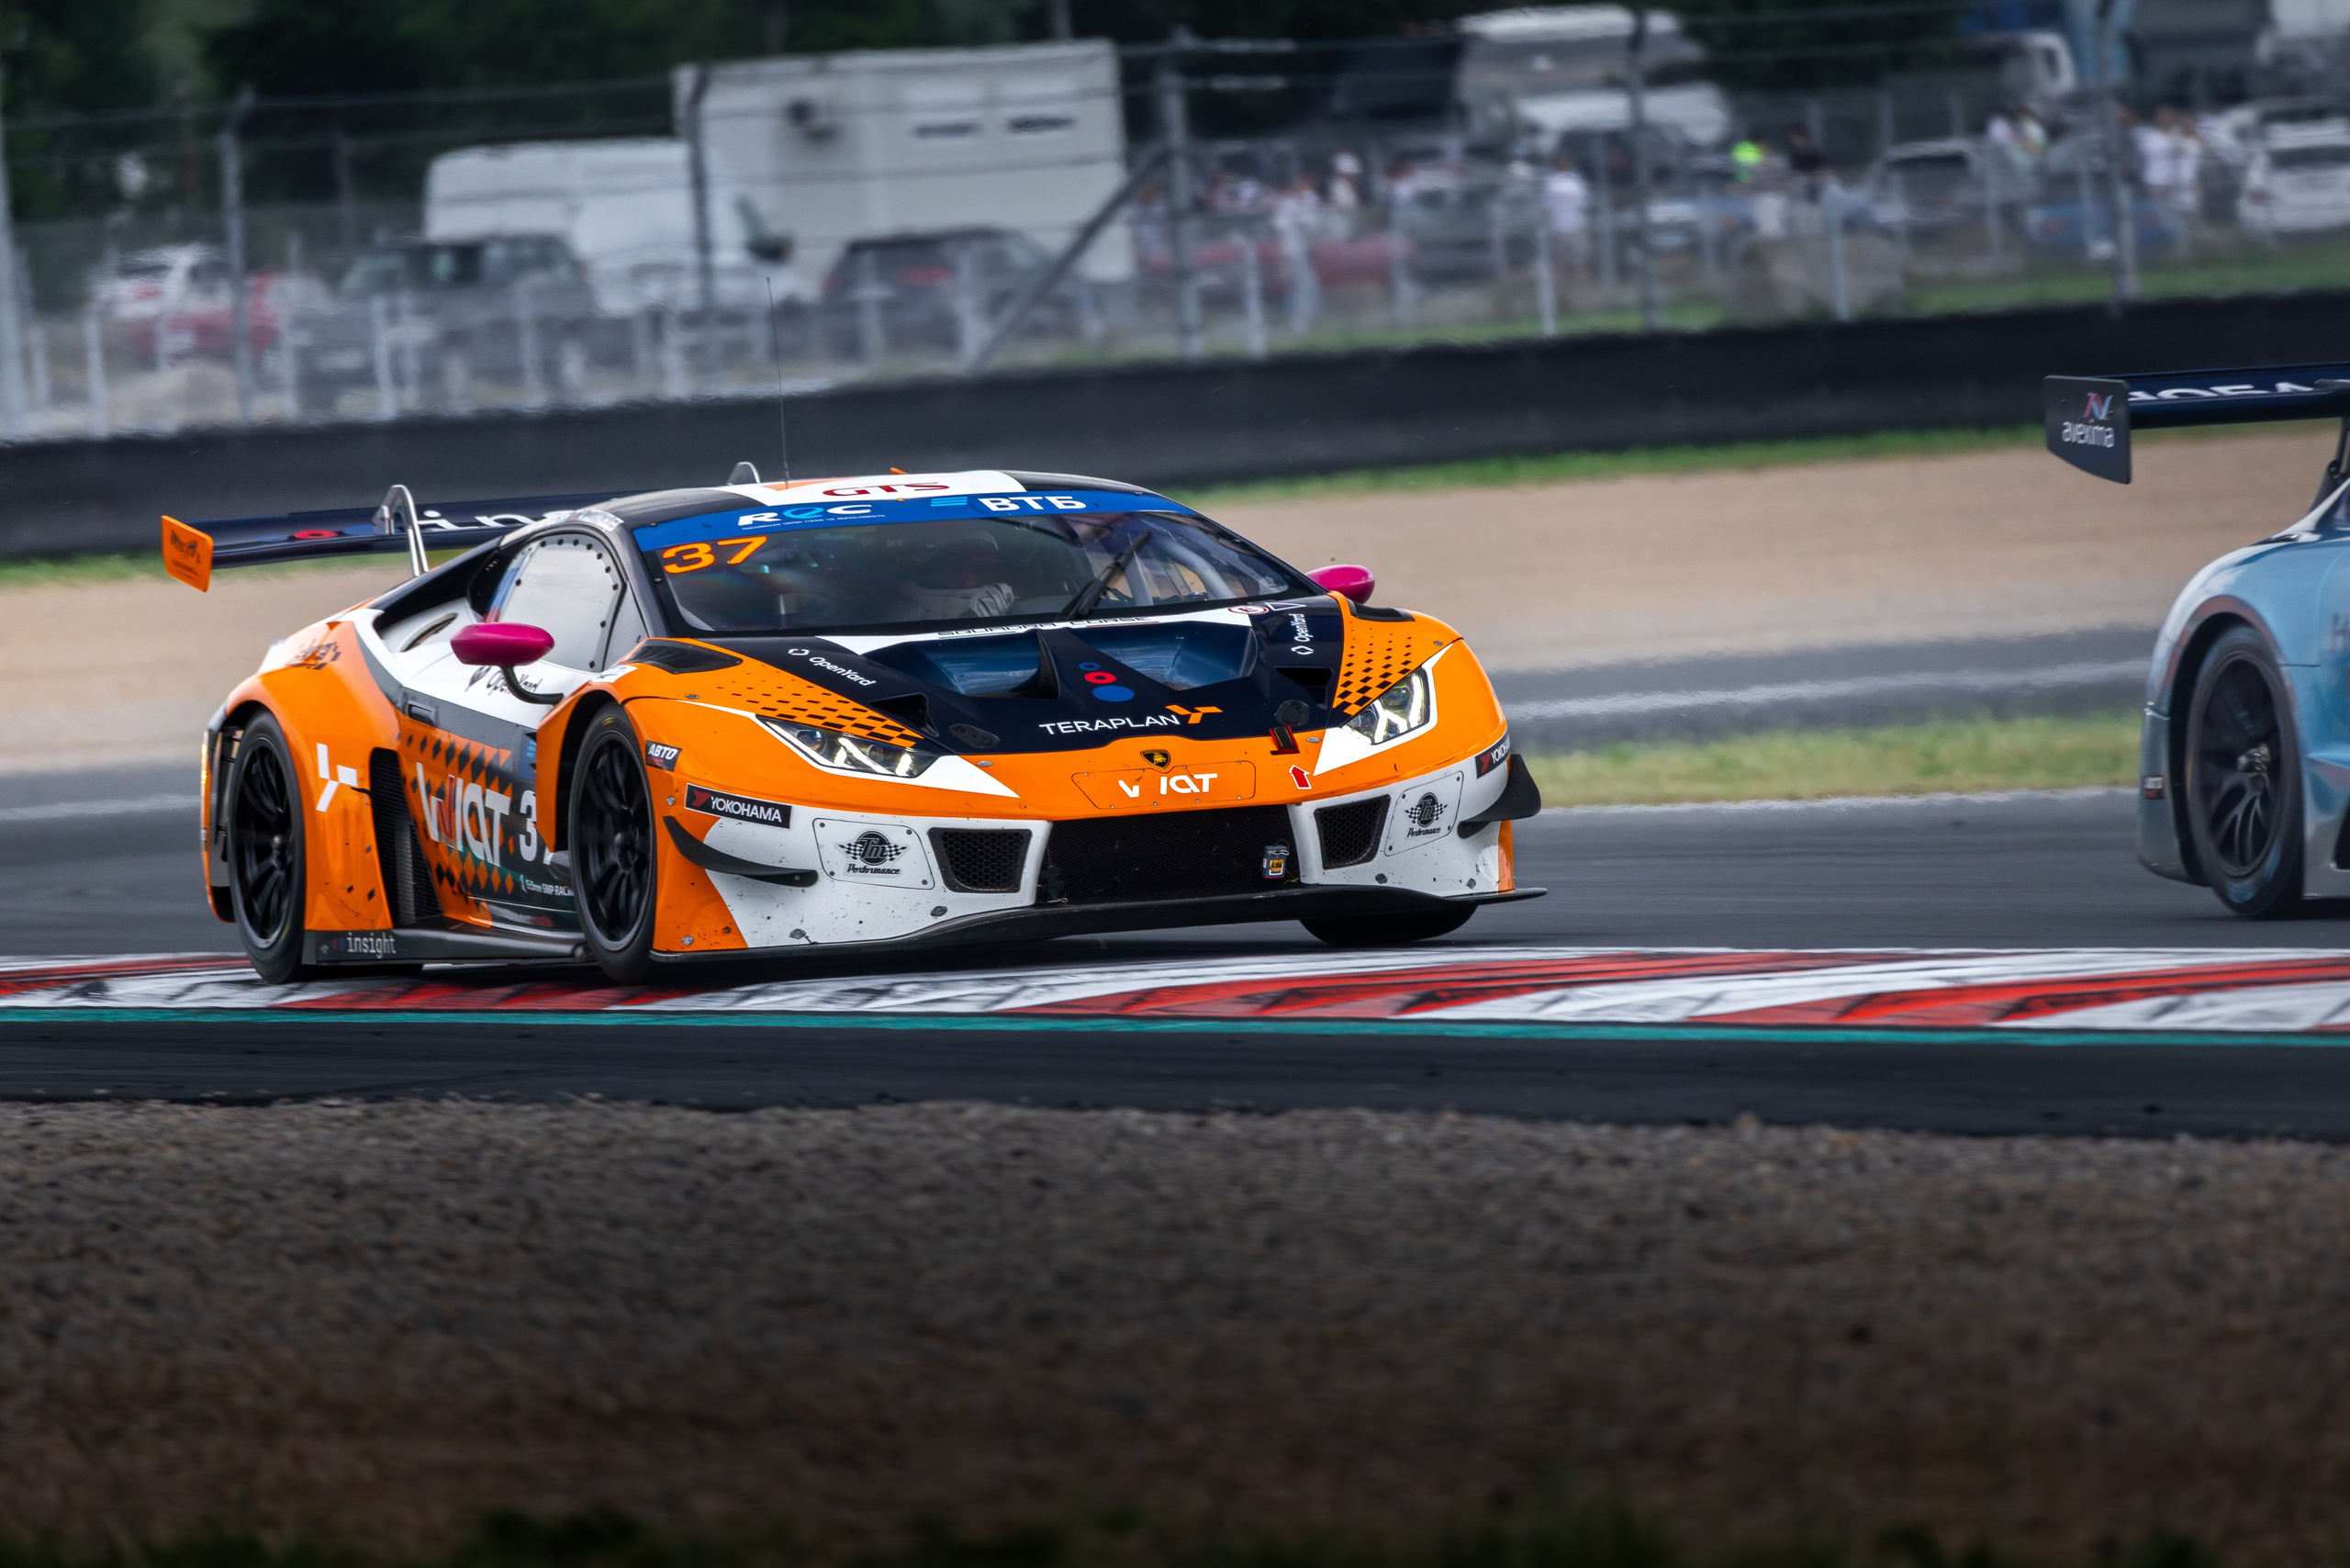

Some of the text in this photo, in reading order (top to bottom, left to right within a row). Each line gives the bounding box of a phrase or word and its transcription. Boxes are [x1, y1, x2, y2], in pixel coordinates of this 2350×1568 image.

[662, 535, 767, 574] 37
[809, 656, 877, 686] OpenYard
[1038, 714, 1181, 735] TERAPLAN
[711, 795, 782, 823] YOKOHAMA
[846, 863, 901, 875] Performance
[346, 931, 397, 959] insight
